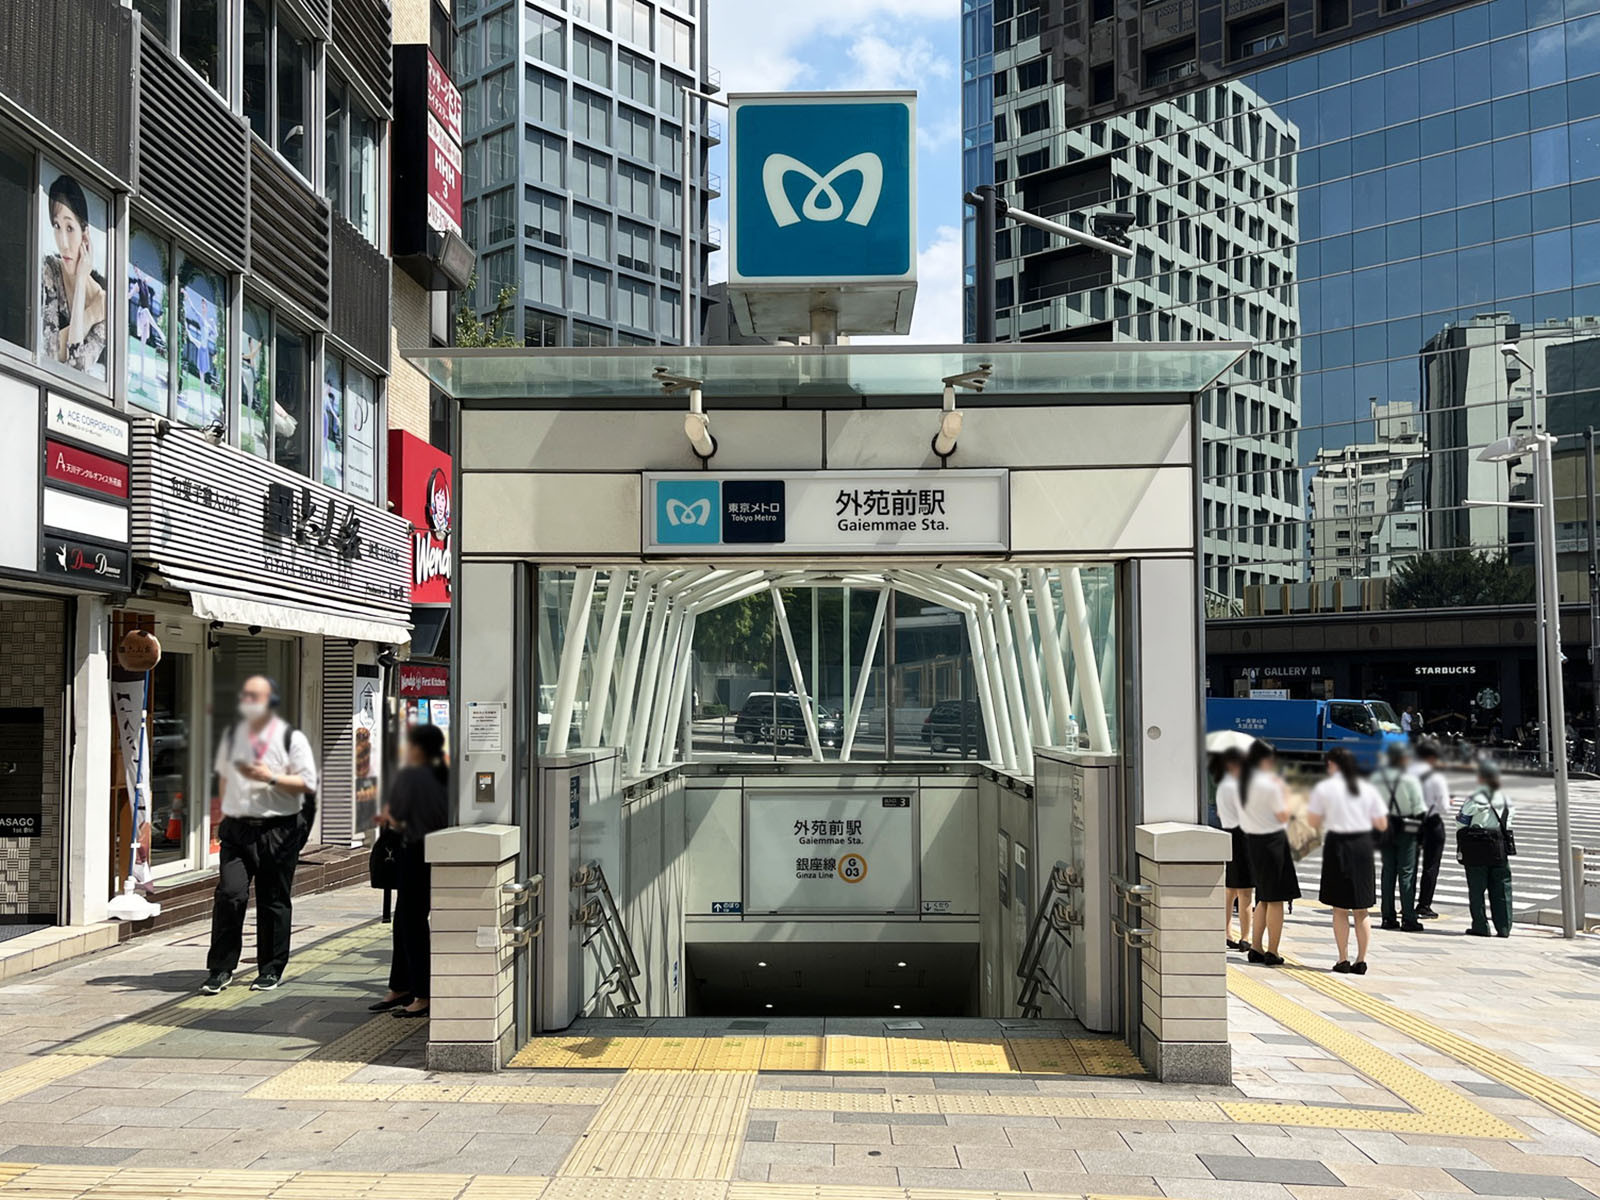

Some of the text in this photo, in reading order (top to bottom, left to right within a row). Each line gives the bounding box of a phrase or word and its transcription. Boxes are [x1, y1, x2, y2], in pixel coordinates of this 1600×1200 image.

[434, 148, 455, 190] HHH
[442, 182, 449, 200] 3
[68, 410, 81, 423] ACE
[81, 415, 123, 438] CORPORATION
[728, 502, 780, 513] 東京メトロ
[836, 489, 945, 516] 外苑前駅
[731, 514, 777, 523] Tokyo Metro
[837, 518, 949, 532] Gaiemmae Sta.
[1264, 667, 1307, 677] GALLERY
[1311, 667, 1320, 676] M
[1415, 666, 1476, 675] STARBUCKS
[900, 798, 906, 807] 3
[793, 820, 863, 836] 外苑前駅
[799, 836, 864, 845] Gaiemmae Sta.
[796, 857, 837, 872] 銀座線
[848, 858, 857, 867] G
[796, 871, 834, 879] Ginza Line
[845, 867, 860, 878] 03
